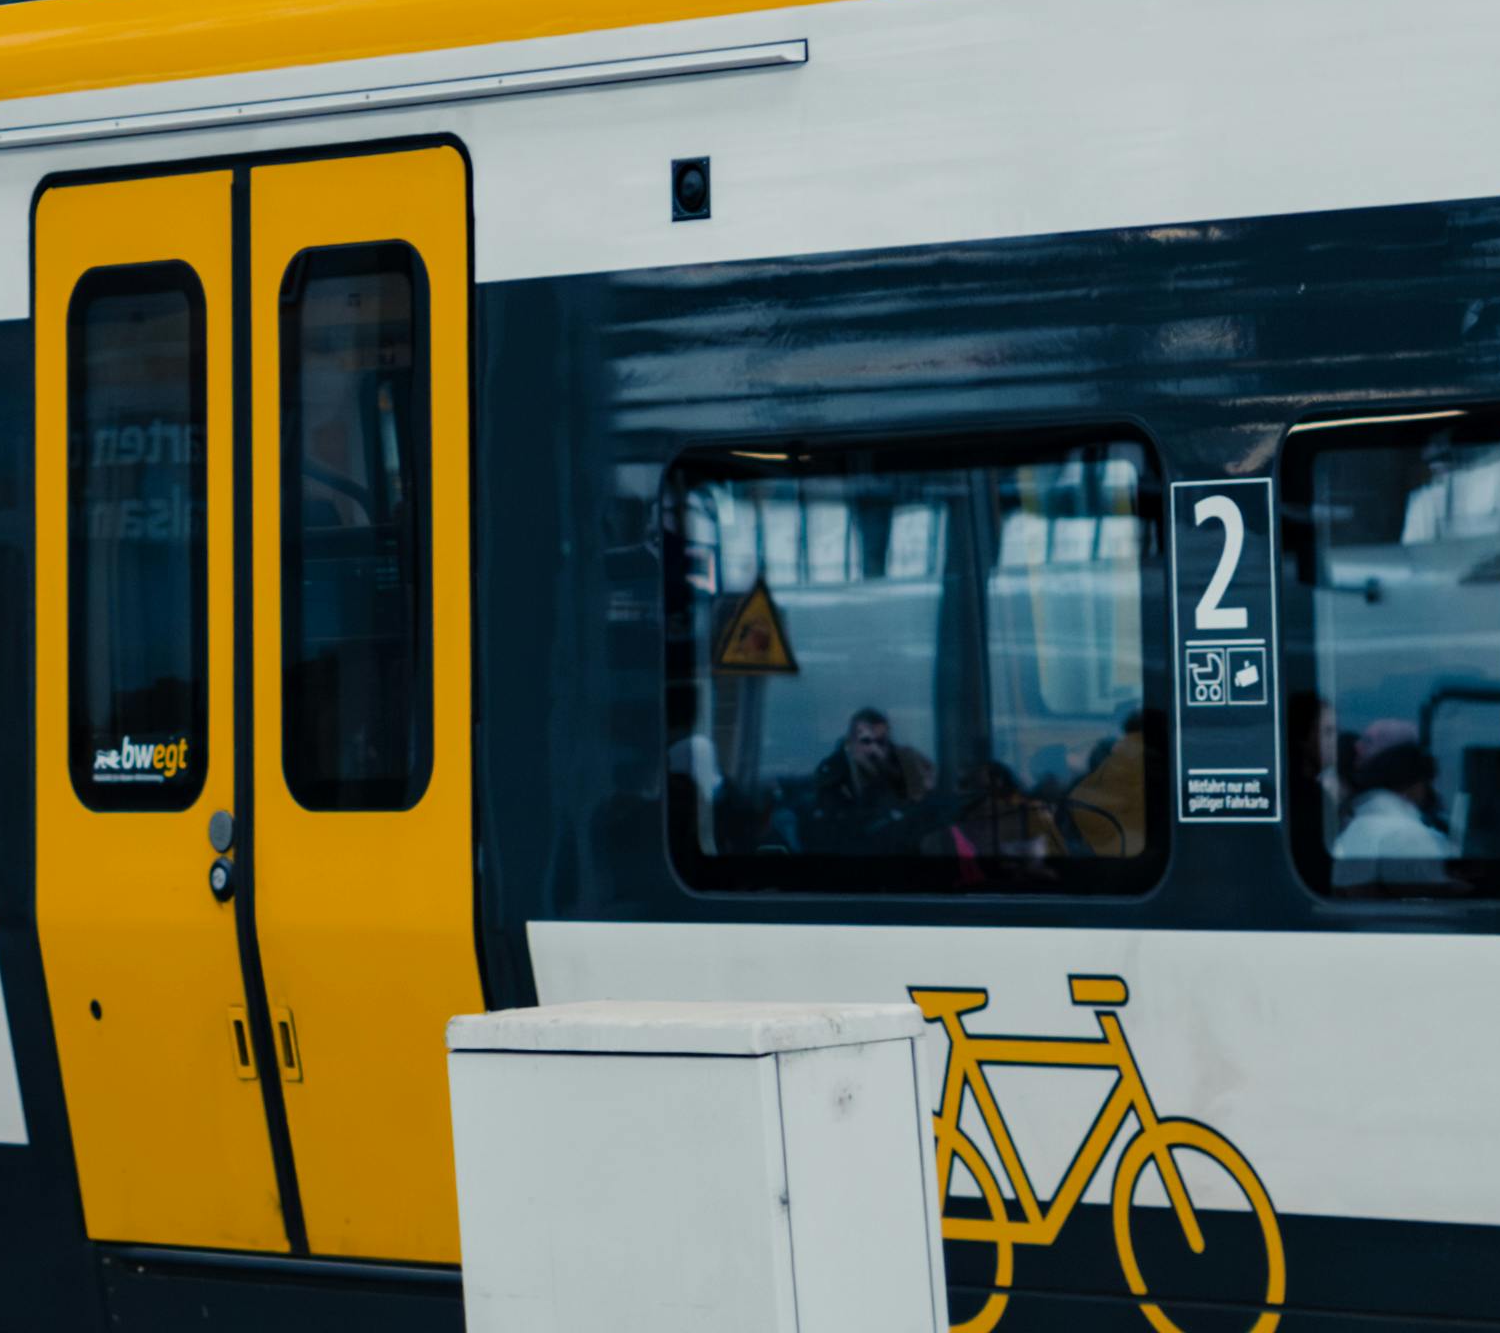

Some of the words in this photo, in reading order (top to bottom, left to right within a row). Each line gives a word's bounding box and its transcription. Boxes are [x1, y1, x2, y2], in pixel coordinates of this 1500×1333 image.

[1193, 495, 1249, 631] 2
[122, 735, 189, 778] bwegt
[1188, 778, 1226, 794] Mitfahrt
[1227, 781, 1243, 794] nur
[1244, 779, 1261, 794] mit
[1225, 795, 1270, 810] Fahrkarte
